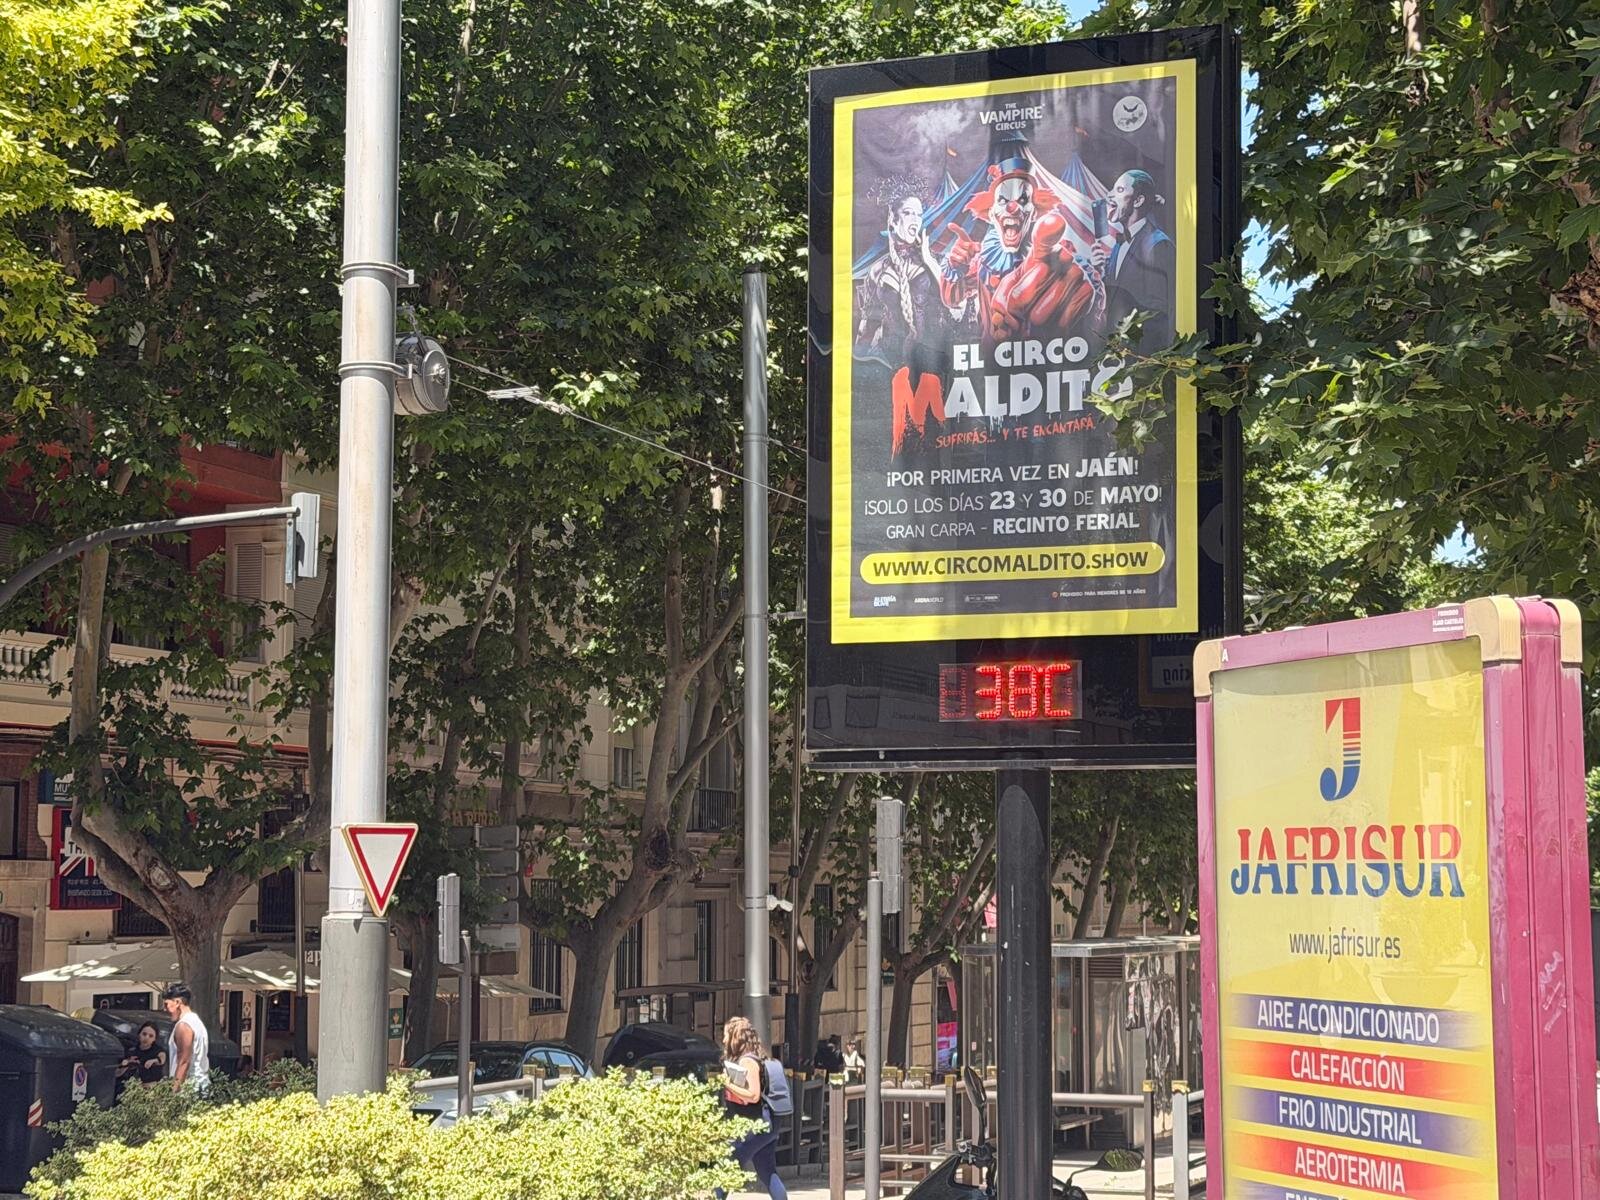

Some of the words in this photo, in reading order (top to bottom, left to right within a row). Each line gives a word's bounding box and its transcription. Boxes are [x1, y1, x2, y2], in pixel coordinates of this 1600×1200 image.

[979, 106, 1043, 125] VAMPIRE
[1005, 102, 1017, 110] THE
[995, 121, 1027, 131] CIRCUS
[953, 343, 985, 371] EL
[994, 336, 1089, 368] CIRCO
[1002, 428, 1010, 440] Y
[1014, 425, 1028, 439] TE
[886, 470, 924, 488] ¡POR
[930, 466, 1004, 486] PRIMERA
[1009, 464, 1042, 482] VEZ
[1048, 463, 1070, 480] EN
[1075, 451, 1139, 478] JAÉN!
[864, 499, 908, 516] ¡SOLO
[914, 496, 944, 514] LOS
[949, 491, 985, 513] DÍAS
[989, 491, 1015, 510] 23
[1021, 493, 1034, 508] Y
[1039, 488, 1067, 507] 30
[1074, 490, 1095, 506] DE
[1100, 485, 1163, 505] MAYO!
[886, 524, 926, 540] GRAN
[930, 522, 976, 538] CARPA
[993, 515, 1070, 535] RECINTO
[1076, 512, 1140, 531] FERIAL
[873, 551, 1149, 577] WWW.CIRCOMALDITO.SHOW
[1221, 648, 1229, 662] A
[1230, 824, 1465, 898] JAFRISUR
[1289, 926, 1401, 963] www.jafrisur.es
[1257, 999, 1294, 1029] AIRE
[1298, 1003, 1440, 1043] ACONDICIONADO
[1290, 1050, 1405, 1092] CALEFACCIÓN
[1279, 1096, 1315, 1128] FRIO
[1320, 1101, 1422, 1145] INDUSTRIAL
[1294, 1146, 1406, 1193] AEROTERMIA
